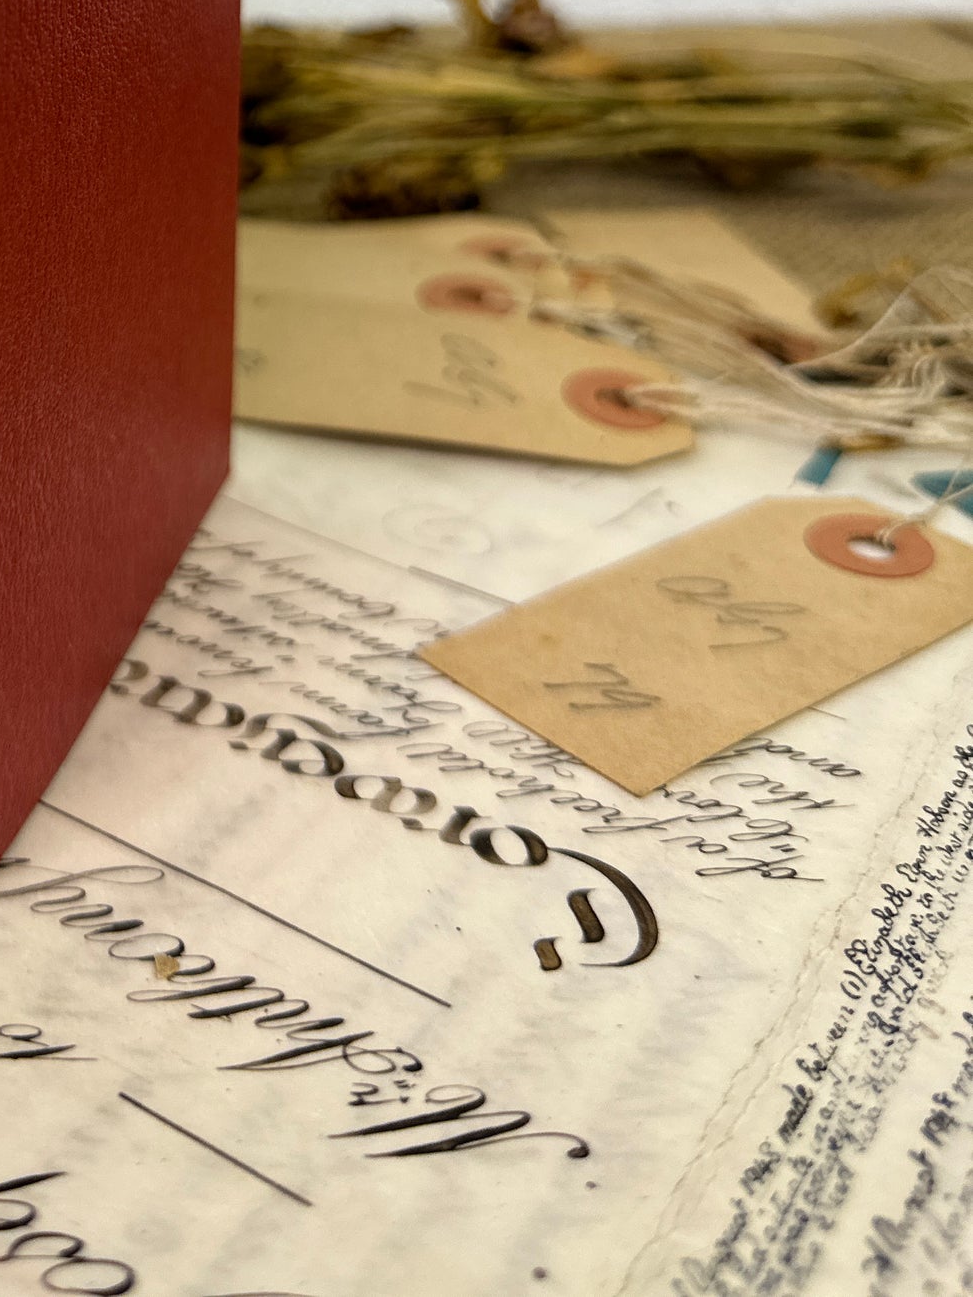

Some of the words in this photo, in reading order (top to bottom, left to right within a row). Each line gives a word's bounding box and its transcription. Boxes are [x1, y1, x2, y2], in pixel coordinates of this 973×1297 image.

[399, 740, 682, 834] freehold
[663, 836, 729, 856] a
[696, 854, 824, 883] of
[842, 880, 915, 978] Elizabeth
[840, 970, 870, 1003] (1)
